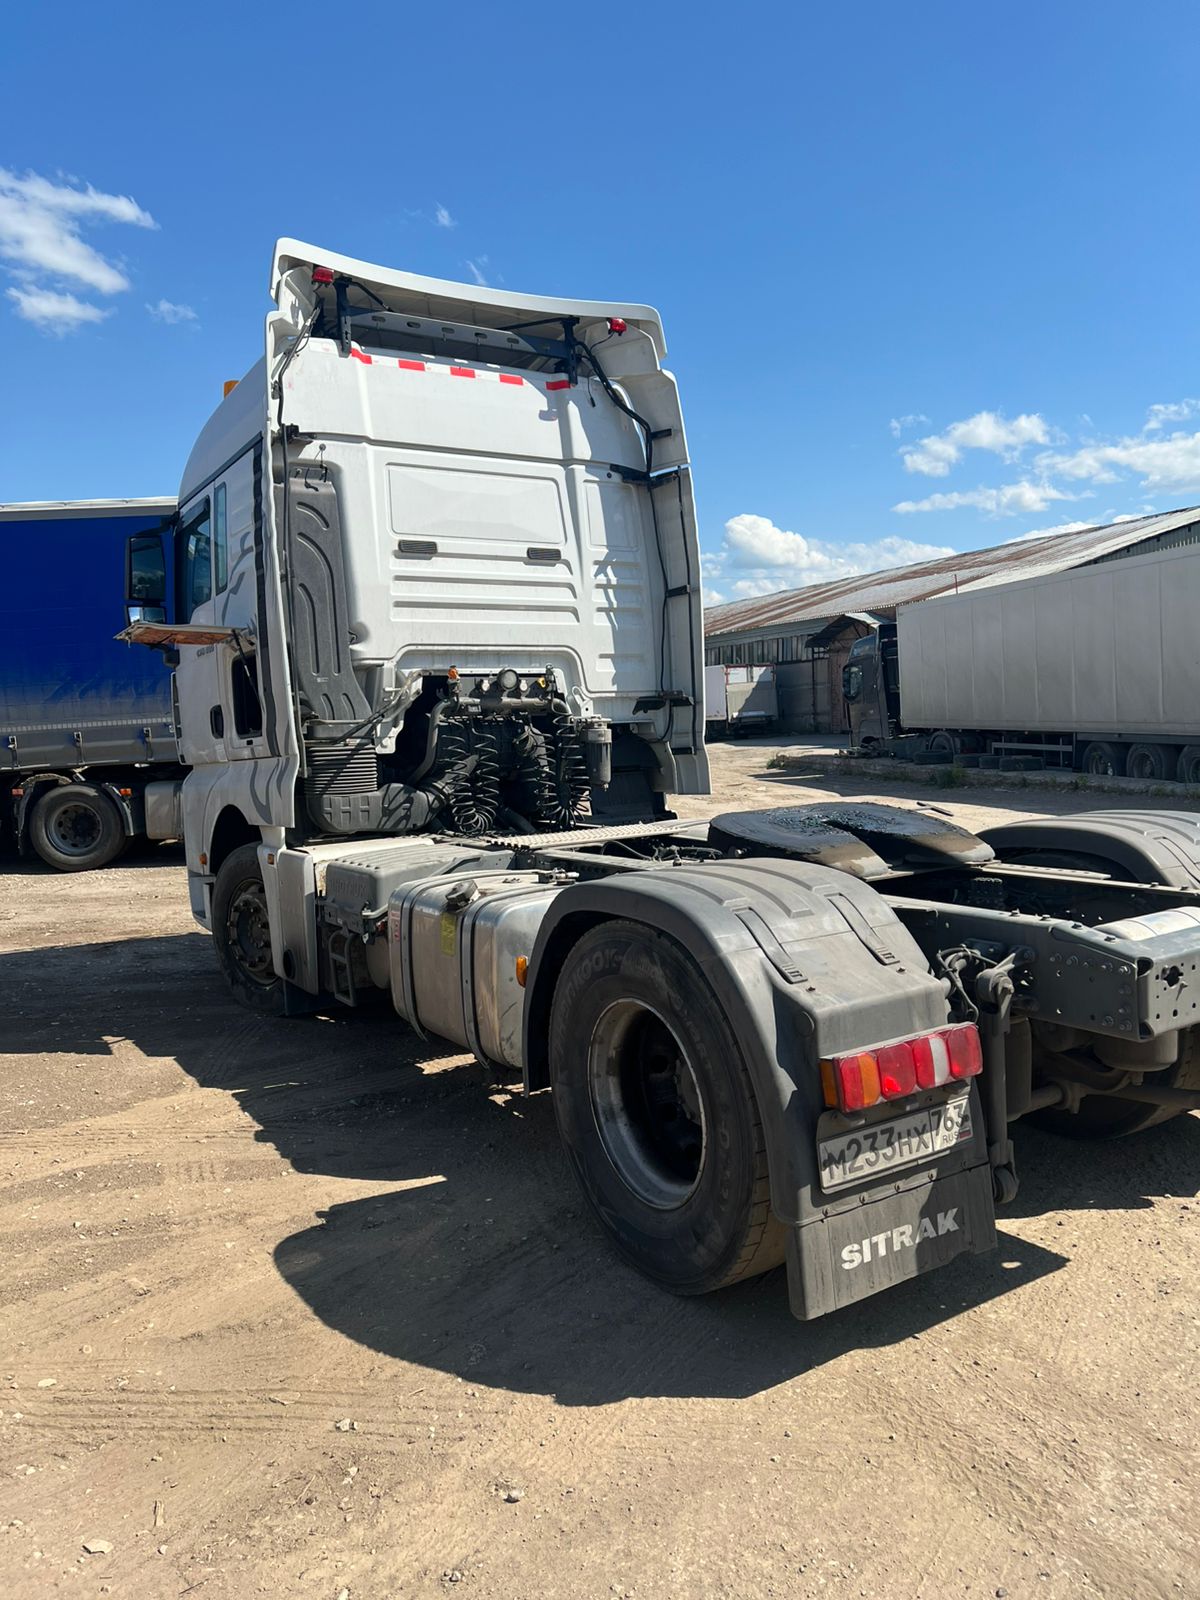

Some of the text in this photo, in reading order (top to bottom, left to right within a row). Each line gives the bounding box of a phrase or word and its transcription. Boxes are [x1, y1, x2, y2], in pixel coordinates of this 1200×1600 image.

[931, 1103, 967, 1137] 763
[942, 1130, 959, 1144] RUS
[841, 1208, 960, 1270] SITRAK
